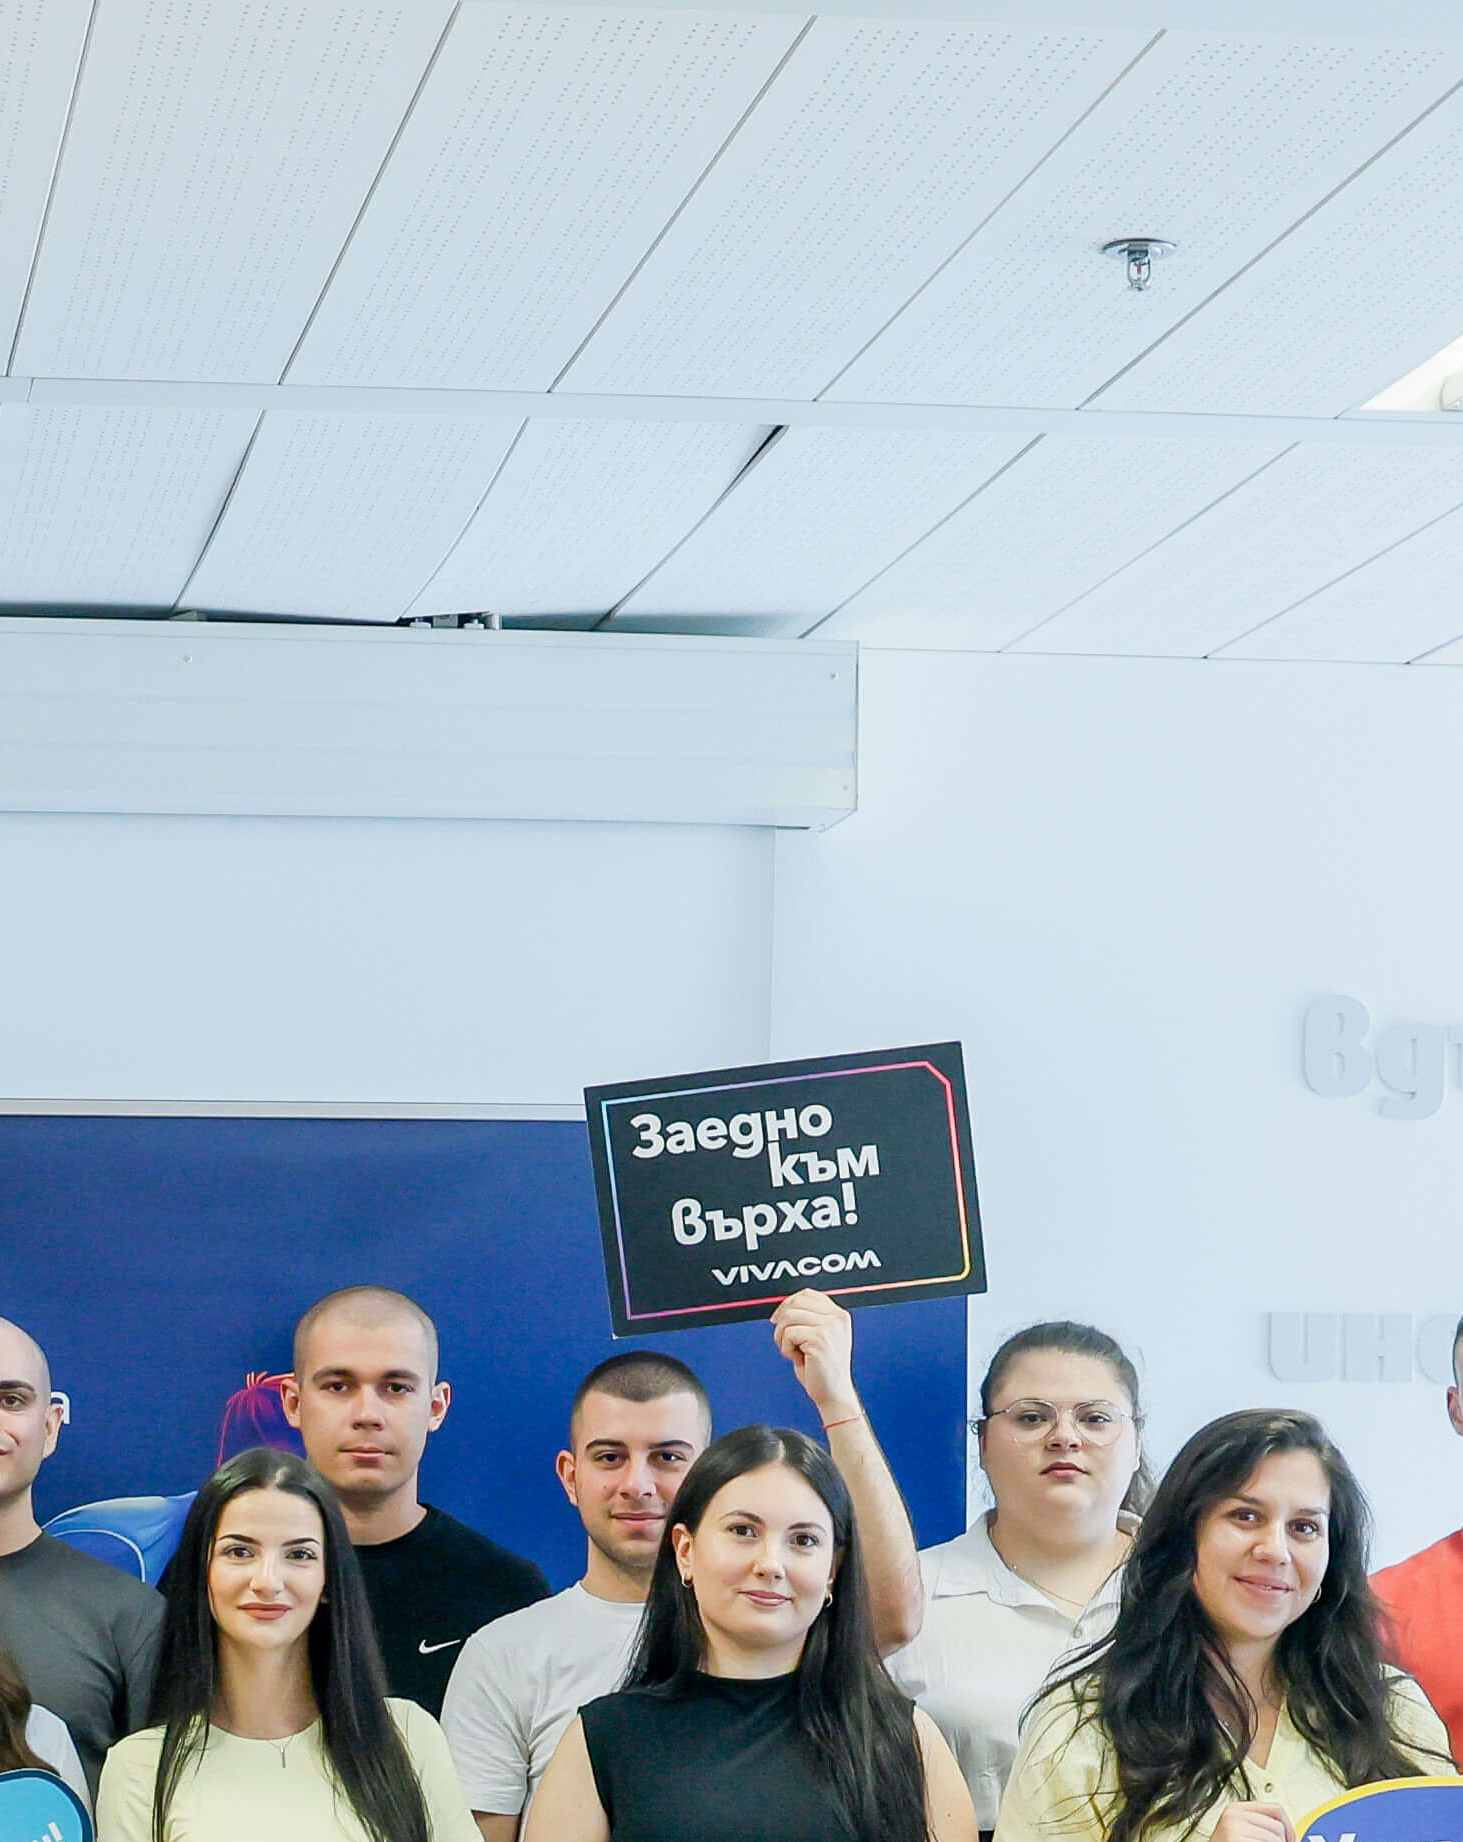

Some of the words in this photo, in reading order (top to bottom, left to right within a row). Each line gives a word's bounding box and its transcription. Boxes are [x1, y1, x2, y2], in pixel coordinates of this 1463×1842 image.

[630, 1102, 833, 1159] Заедно
[768, 1142, 880, 1189] към
[671, 1182, 859, 1251] върха!
[711, 1248, 882, 1287] VIVACOM
